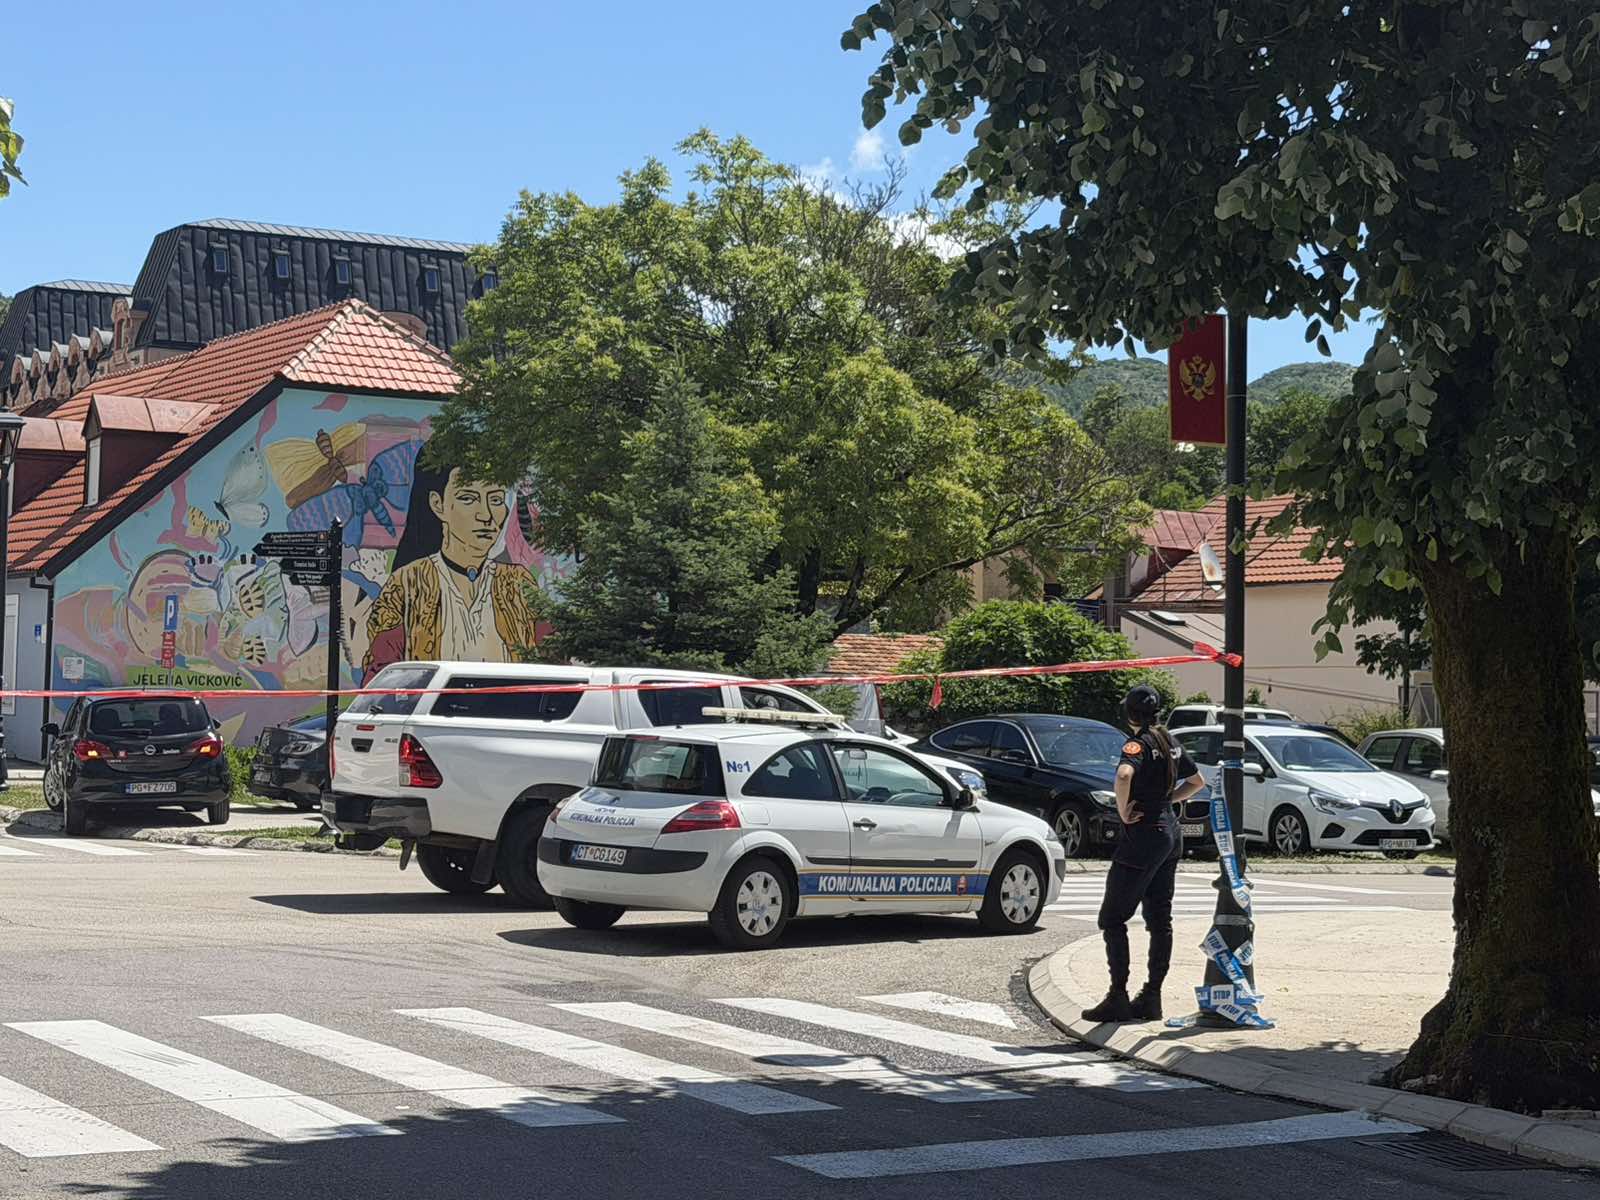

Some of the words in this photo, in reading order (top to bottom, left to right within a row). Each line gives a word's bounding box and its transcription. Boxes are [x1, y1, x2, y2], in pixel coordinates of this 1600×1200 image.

[166, 599, 175, 626] P
[187, 672, 243, 687] VICKOVIĆ
[818, 875, 896, 892] KOMUNALNA
[899, 875, 952, 892] POLICIJA
[1213, 990, 1231, 1000] STOP
